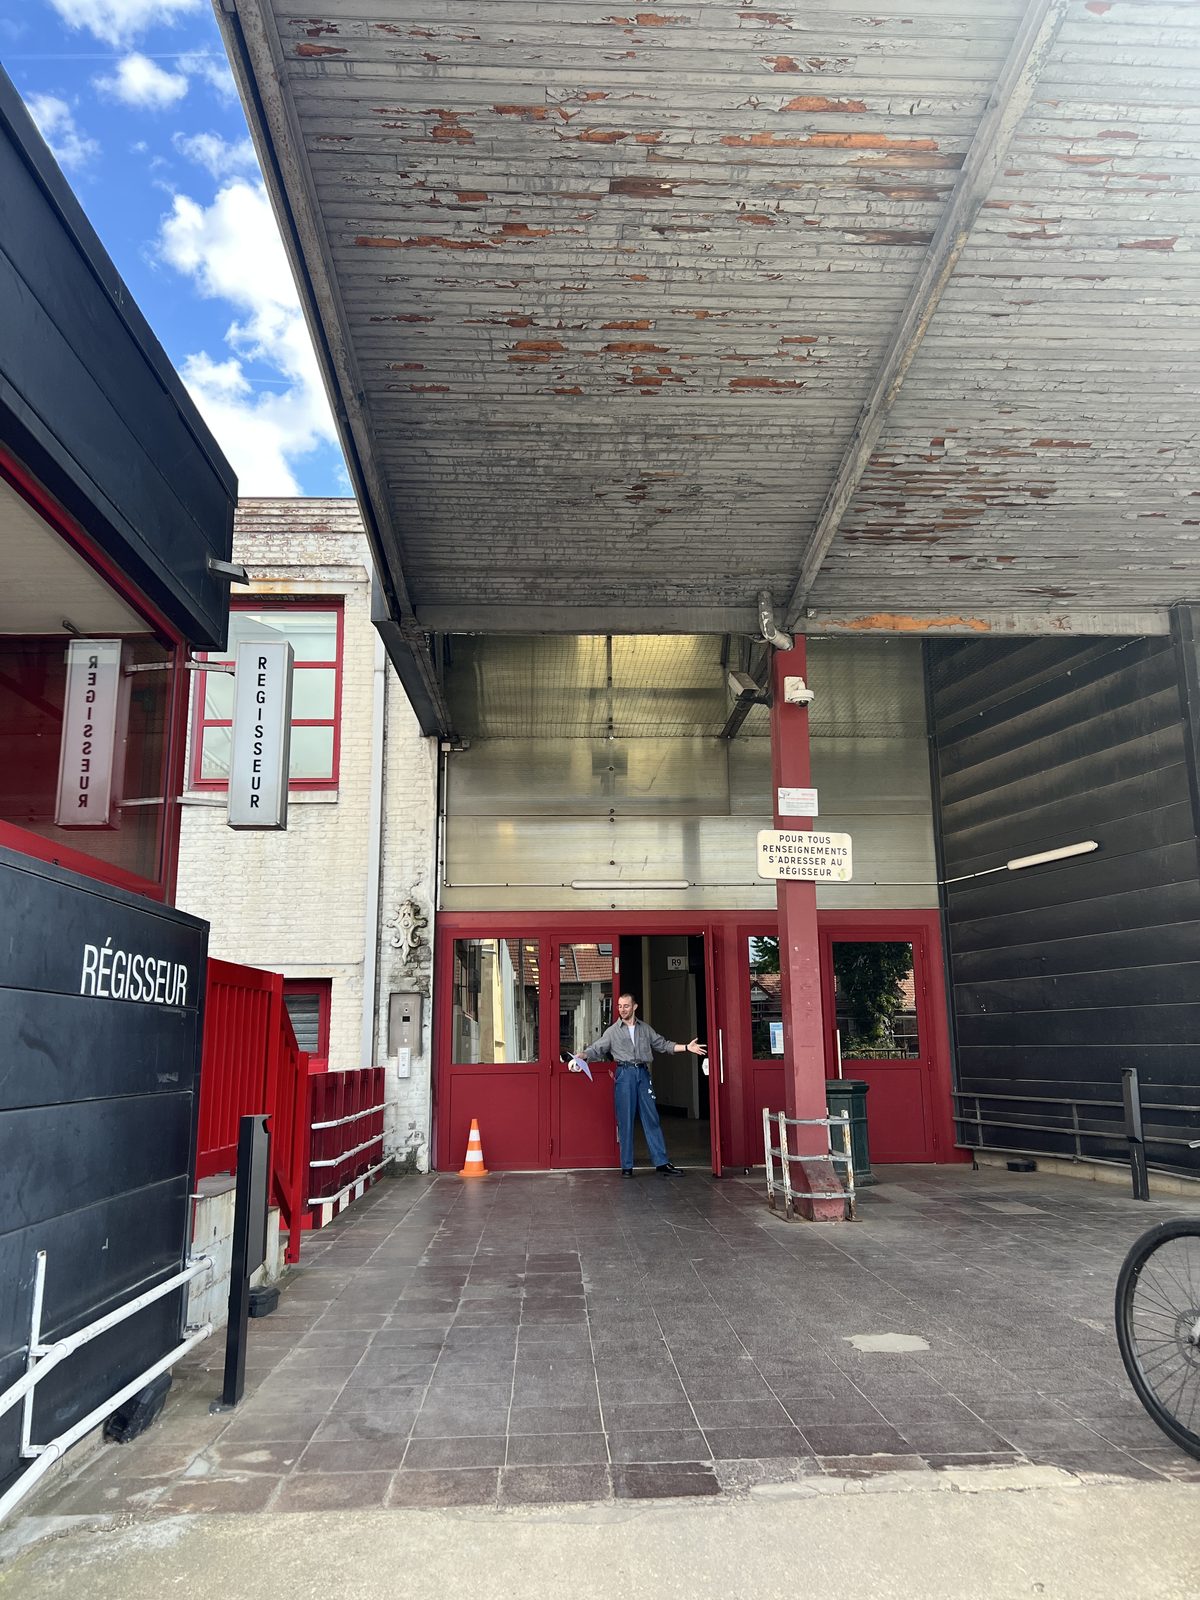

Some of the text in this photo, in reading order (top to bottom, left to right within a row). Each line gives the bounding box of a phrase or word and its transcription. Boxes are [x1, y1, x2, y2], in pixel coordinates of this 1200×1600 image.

[250, 656, 267, 808] REGISSEUR
[779, 834, 831, 844] POUR TOUS
[762, 845, 848, 856] RENSEIGNEMENTS
[768, 855, 842, 866] S'ADRESSER AU
[779, 866, 832, 876] RÉGISSEUR
[671, 958, 682, 967] R9
[80, 937, 188, 1005] RÉGISSEUR
